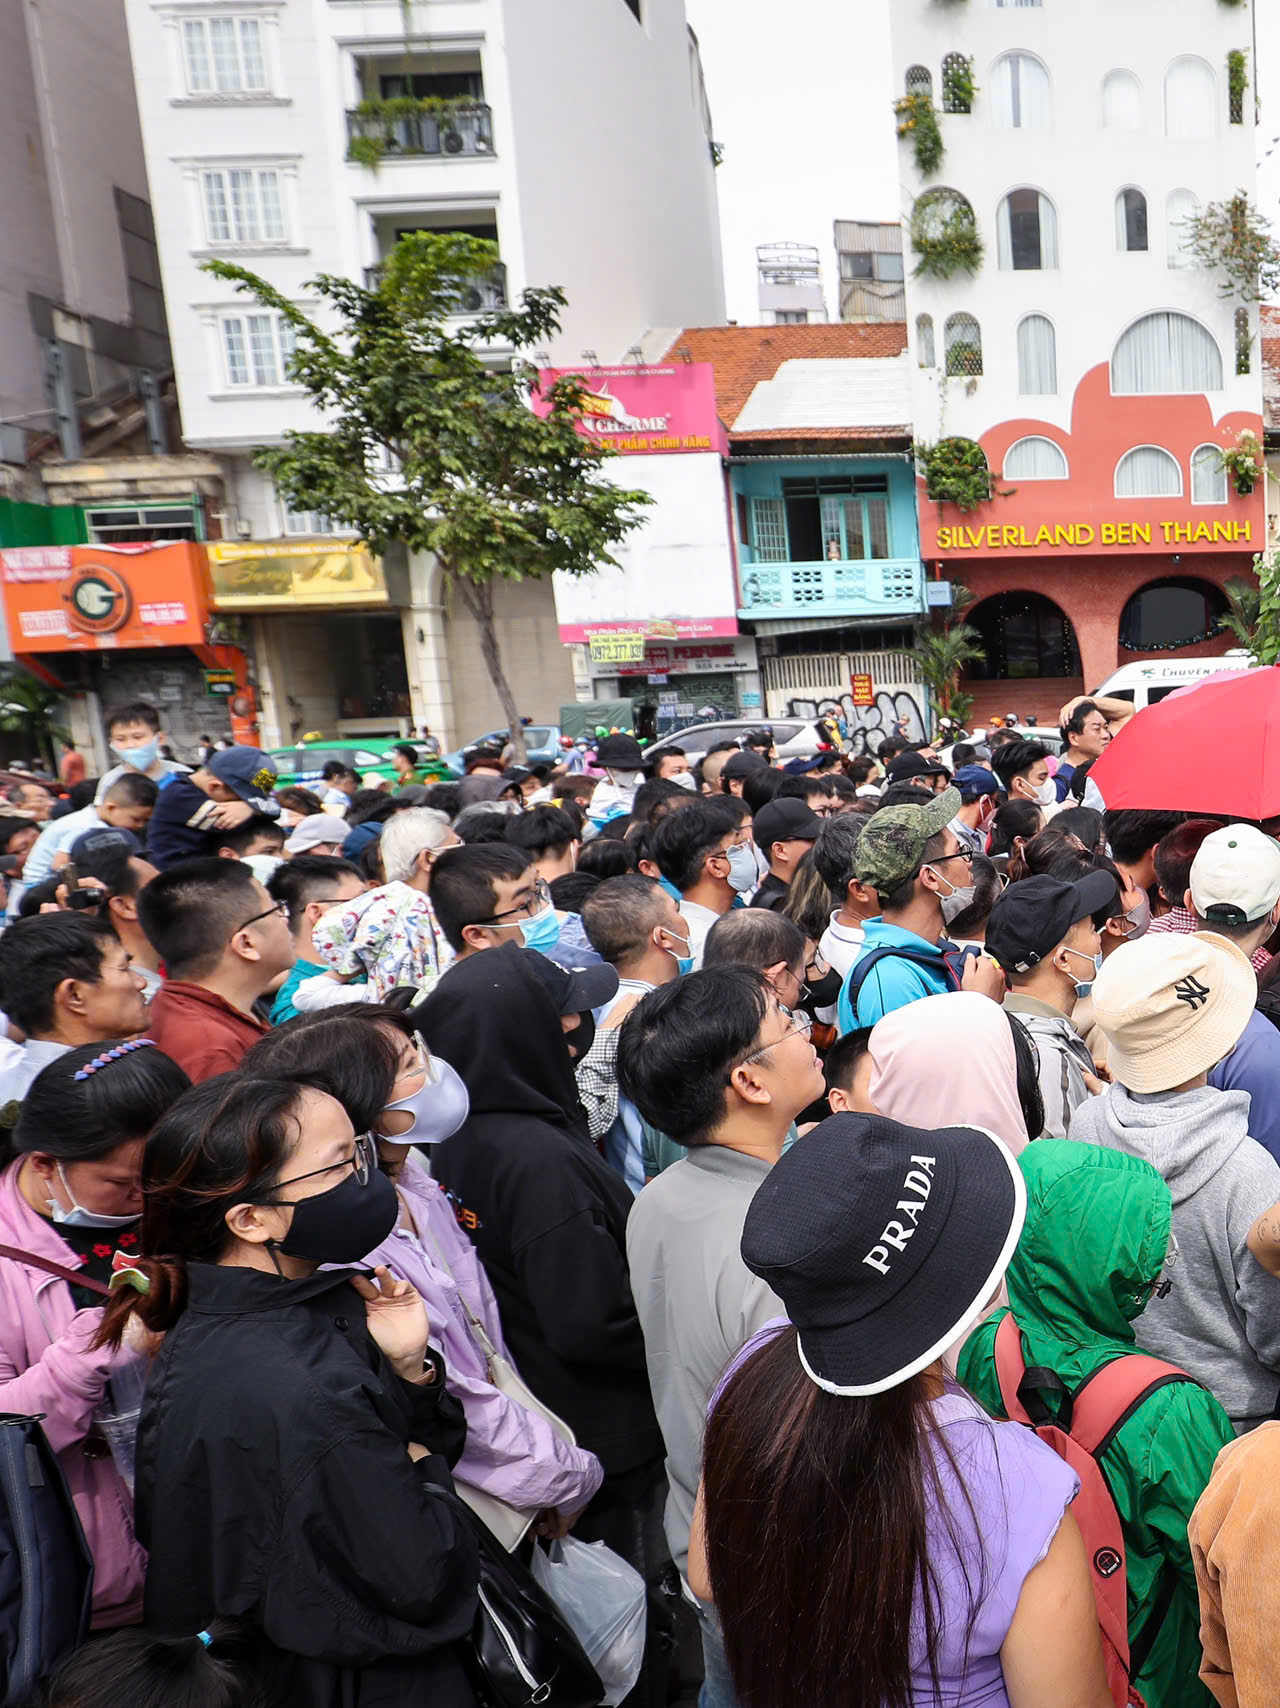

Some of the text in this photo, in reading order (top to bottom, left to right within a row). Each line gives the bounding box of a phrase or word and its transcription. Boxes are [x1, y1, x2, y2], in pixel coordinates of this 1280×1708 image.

[936, 518, 1254, 549] SILVERLAND BEN THANH
[1174, 974, 1210, 1010] NY
[861, 1153, 938, 1277] PRADA
